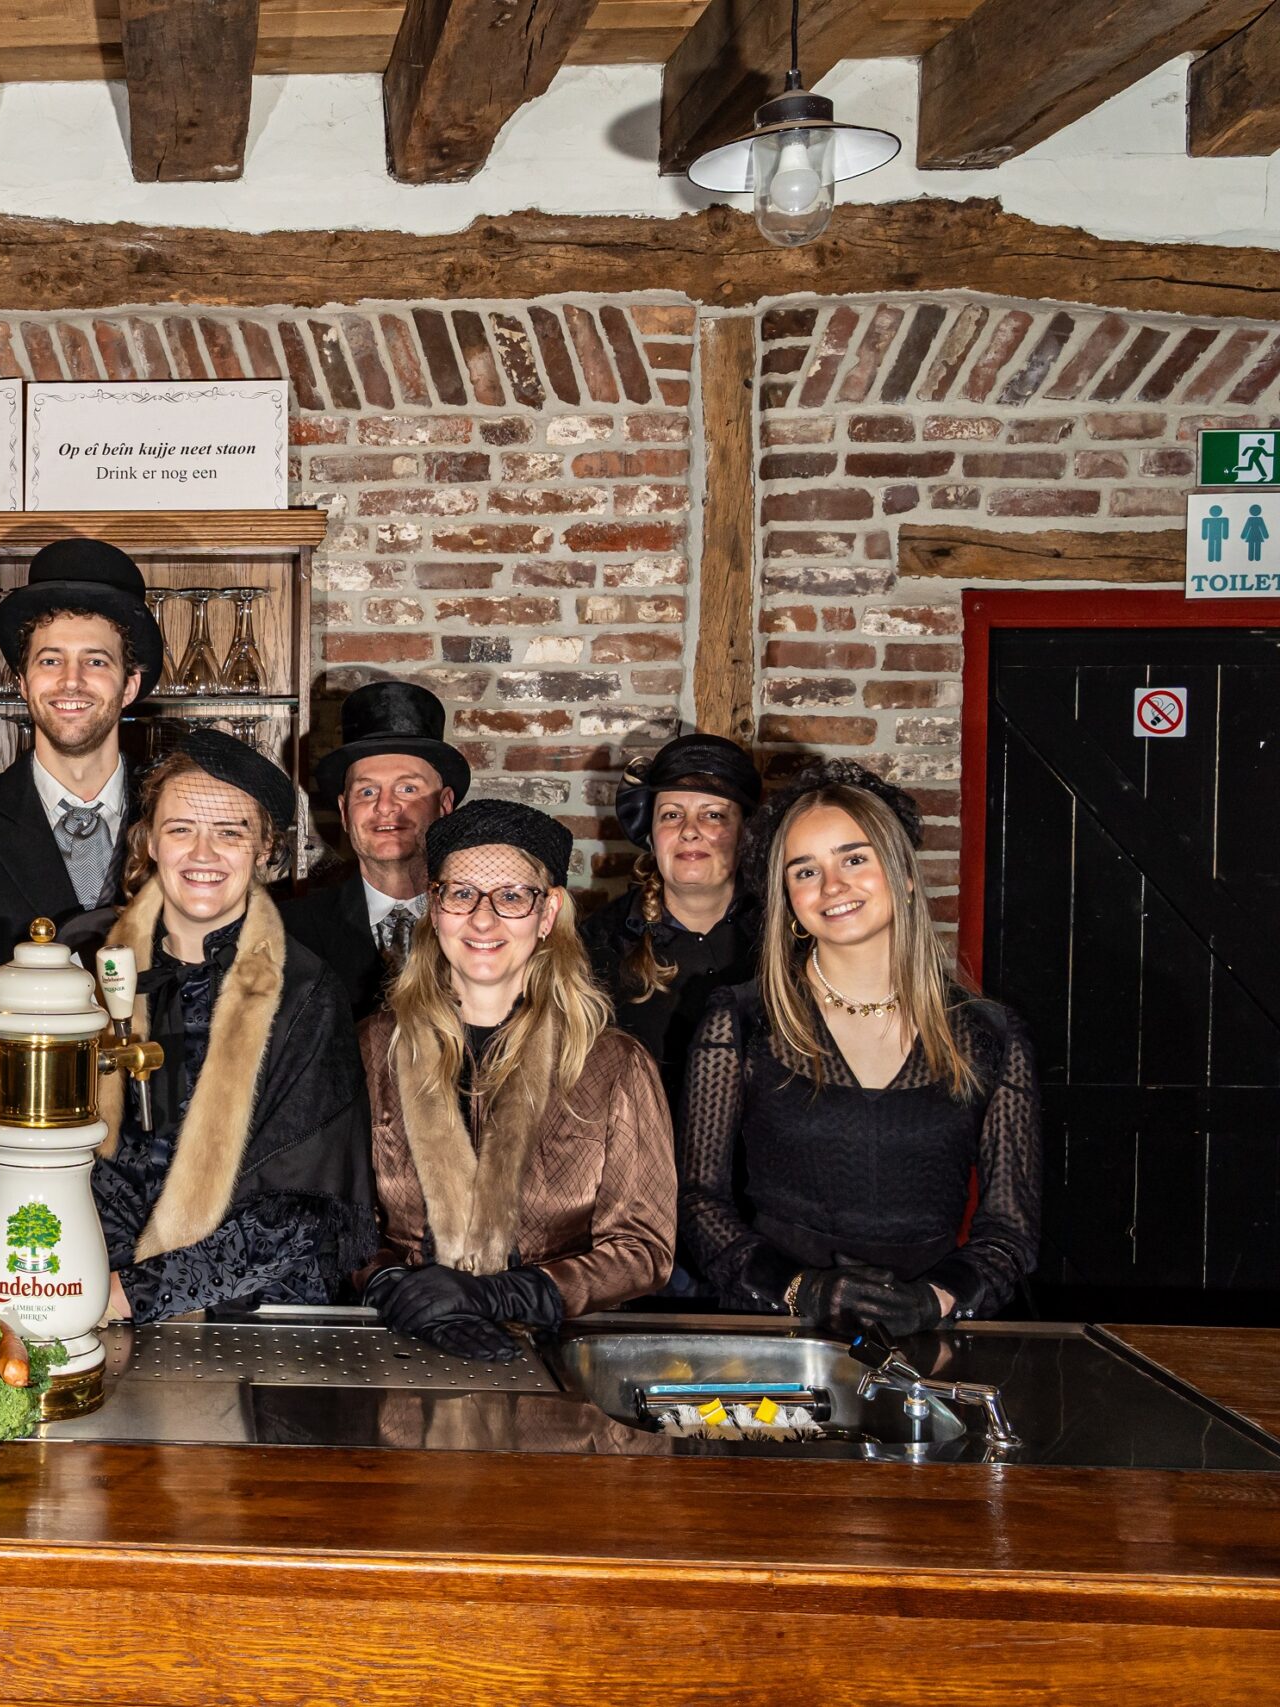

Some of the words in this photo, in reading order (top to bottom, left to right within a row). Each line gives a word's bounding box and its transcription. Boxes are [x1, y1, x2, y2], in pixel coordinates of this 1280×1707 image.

[58, 442, 80, 459] Op
[102, 442, 133, 456] beîn
[138, 442, 176, 459] kujje
[180, 443, 212, 455] neet
[215, 442, 256, 455] staon
[96, 466, 137, 480] Drink
[142, 469, 157, 479] er
[161, 469, 188, 483] nog
[192, 469, 217, 479] een
[20, 1313, 48, 1321] BIEREN
